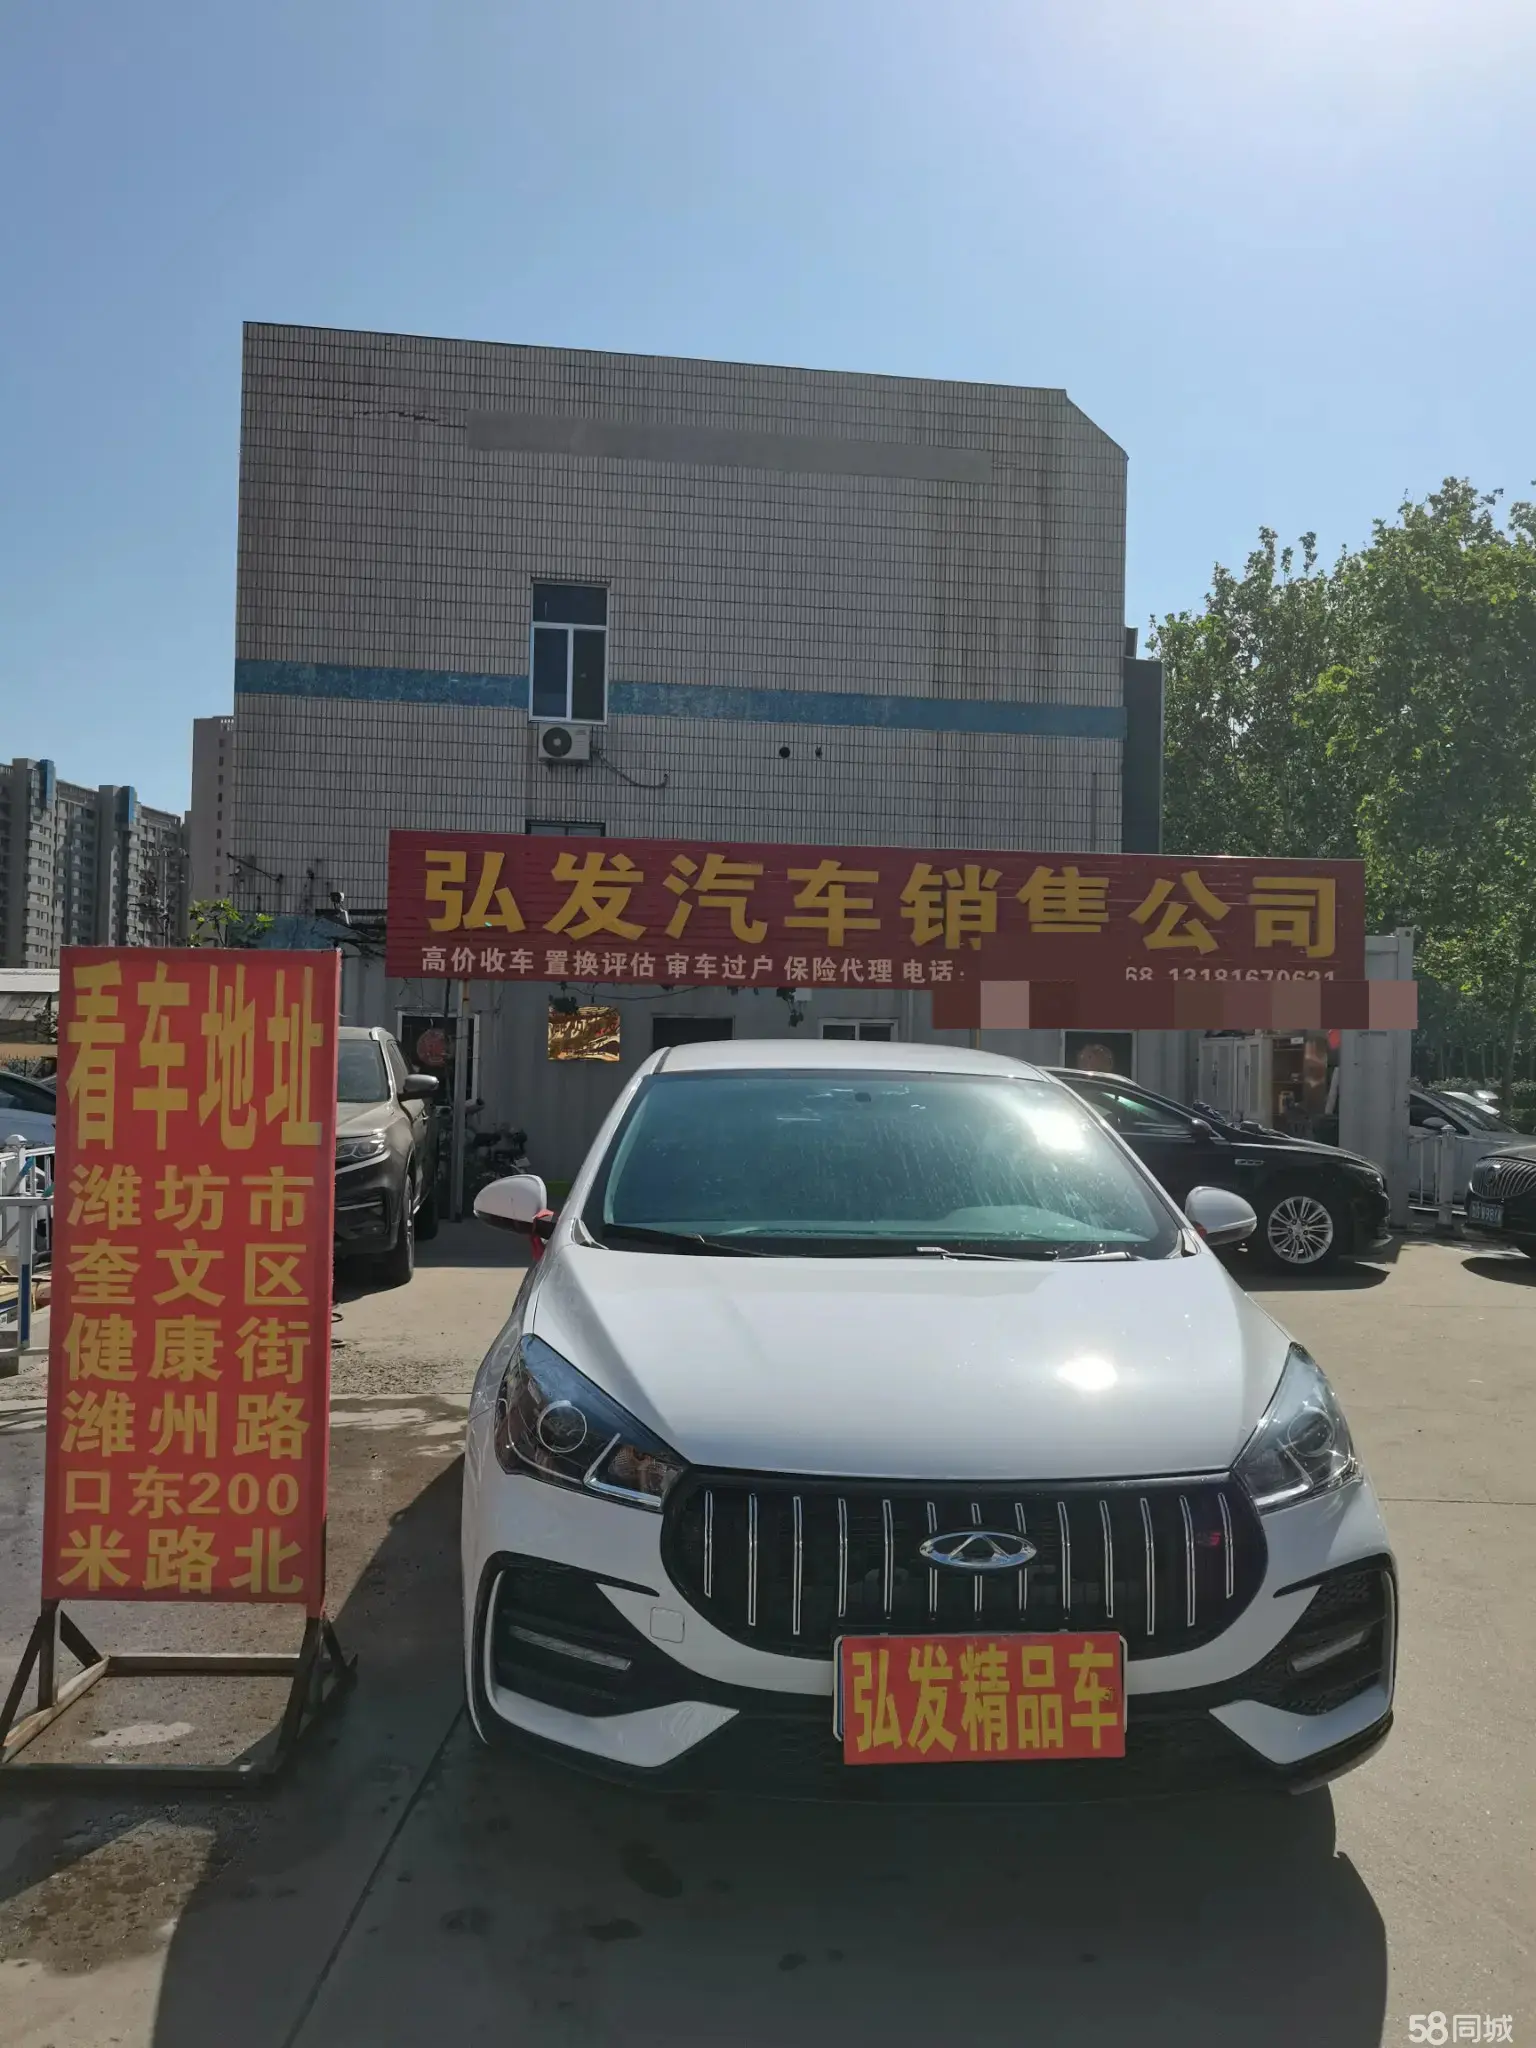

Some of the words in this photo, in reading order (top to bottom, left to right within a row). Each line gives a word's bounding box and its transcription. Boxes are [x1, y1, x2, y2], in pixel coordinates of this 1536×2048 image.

[424, 849, 1337, 959] 弘发汽车销售公司
[421, 945, 534, 974] 高价收车
[544, 949, 656, 977] 置换评估
[665, 952, 774, 980] 审车过户
[784, 955, 893, 983] 保险代理
[65, 959, 324, 1151] 看车地址
[66, 1164, 314, 1232] 潍坊市
[65, 1238, 310, 1307] 奎文区
[62, 1312, 311, 1384] 健康街
[60, 1389, 311, 1460] 潍州路
[64, 1465, 300, 1519] 口东200
[57, 1525, 305, 1595] 米路北
[851, 1641, 1118, 1754] 弘发精品车
